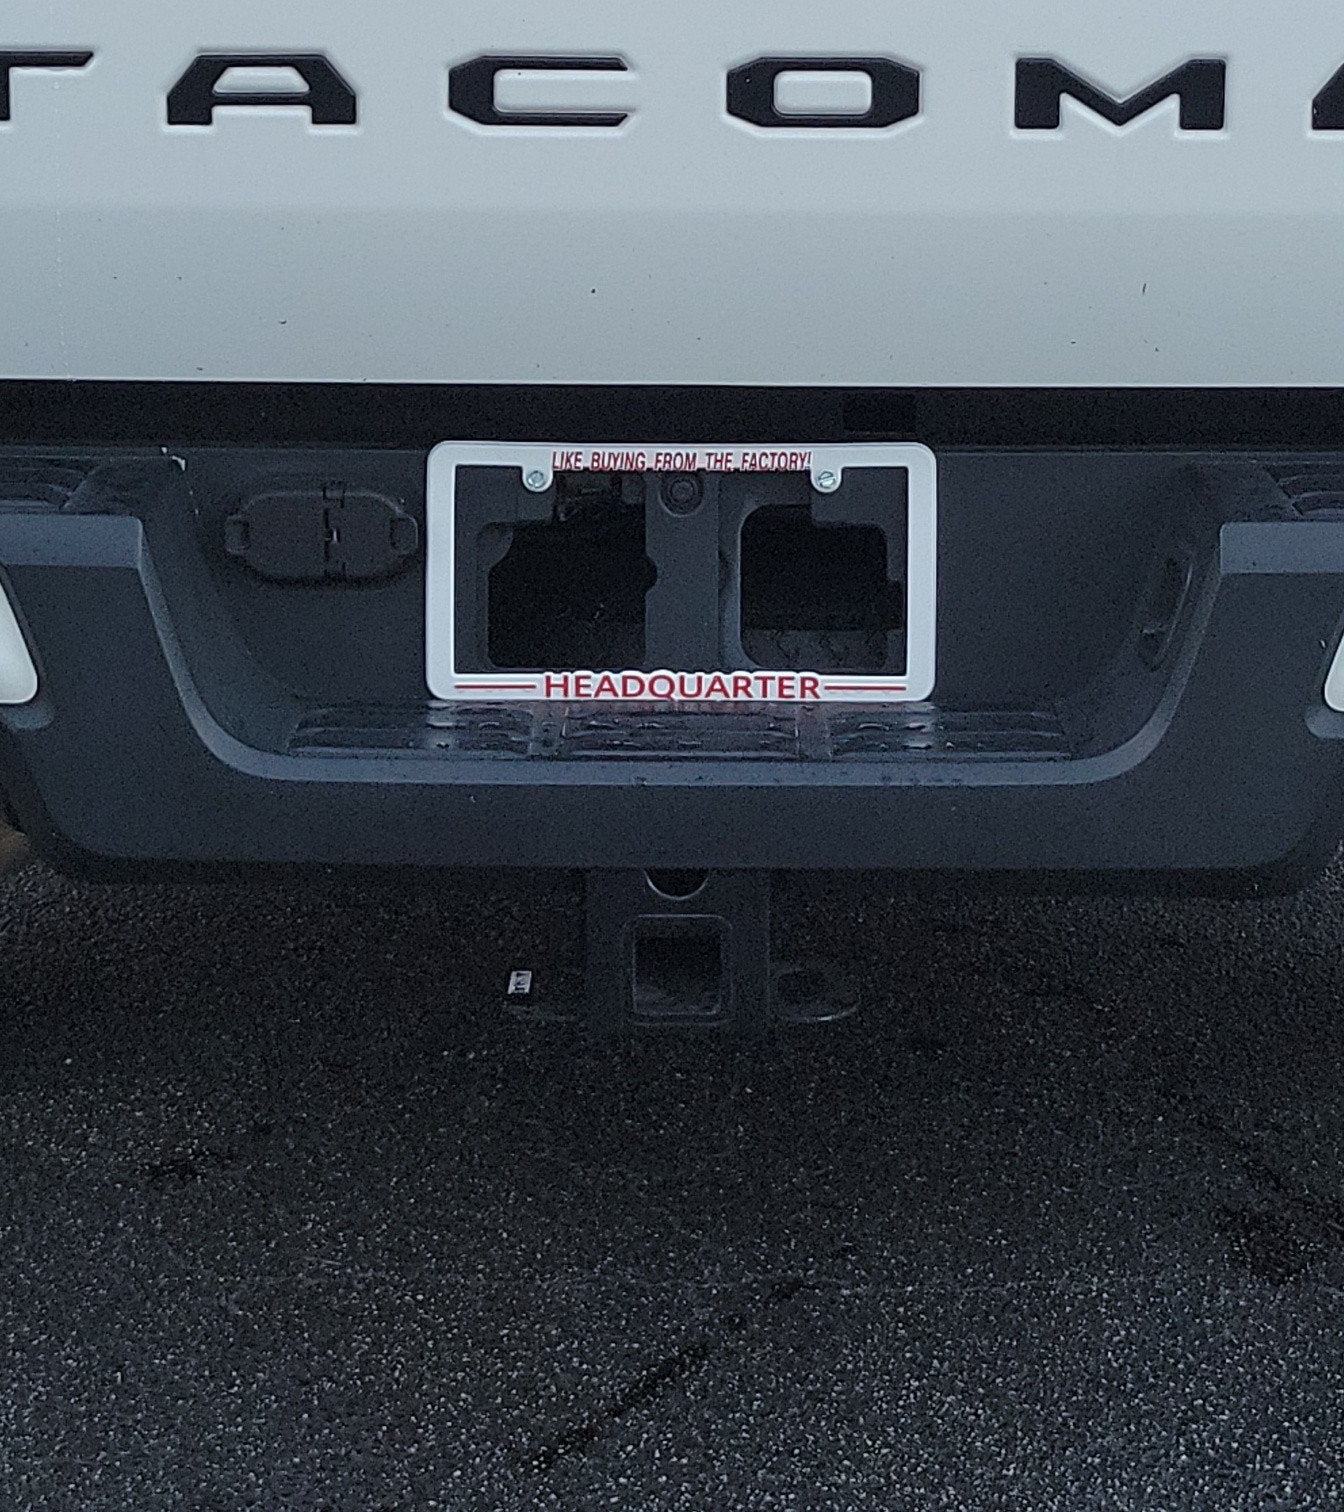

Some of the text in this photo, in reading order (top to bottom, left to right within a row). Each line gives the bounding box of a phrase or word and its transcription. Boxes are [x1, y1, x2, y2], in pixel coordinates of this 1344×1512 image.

[552, 451, 812, 471] LIKE BUYING FROM THE FACTORY!
[544, 675, 820, 700] HEADQUARTER
